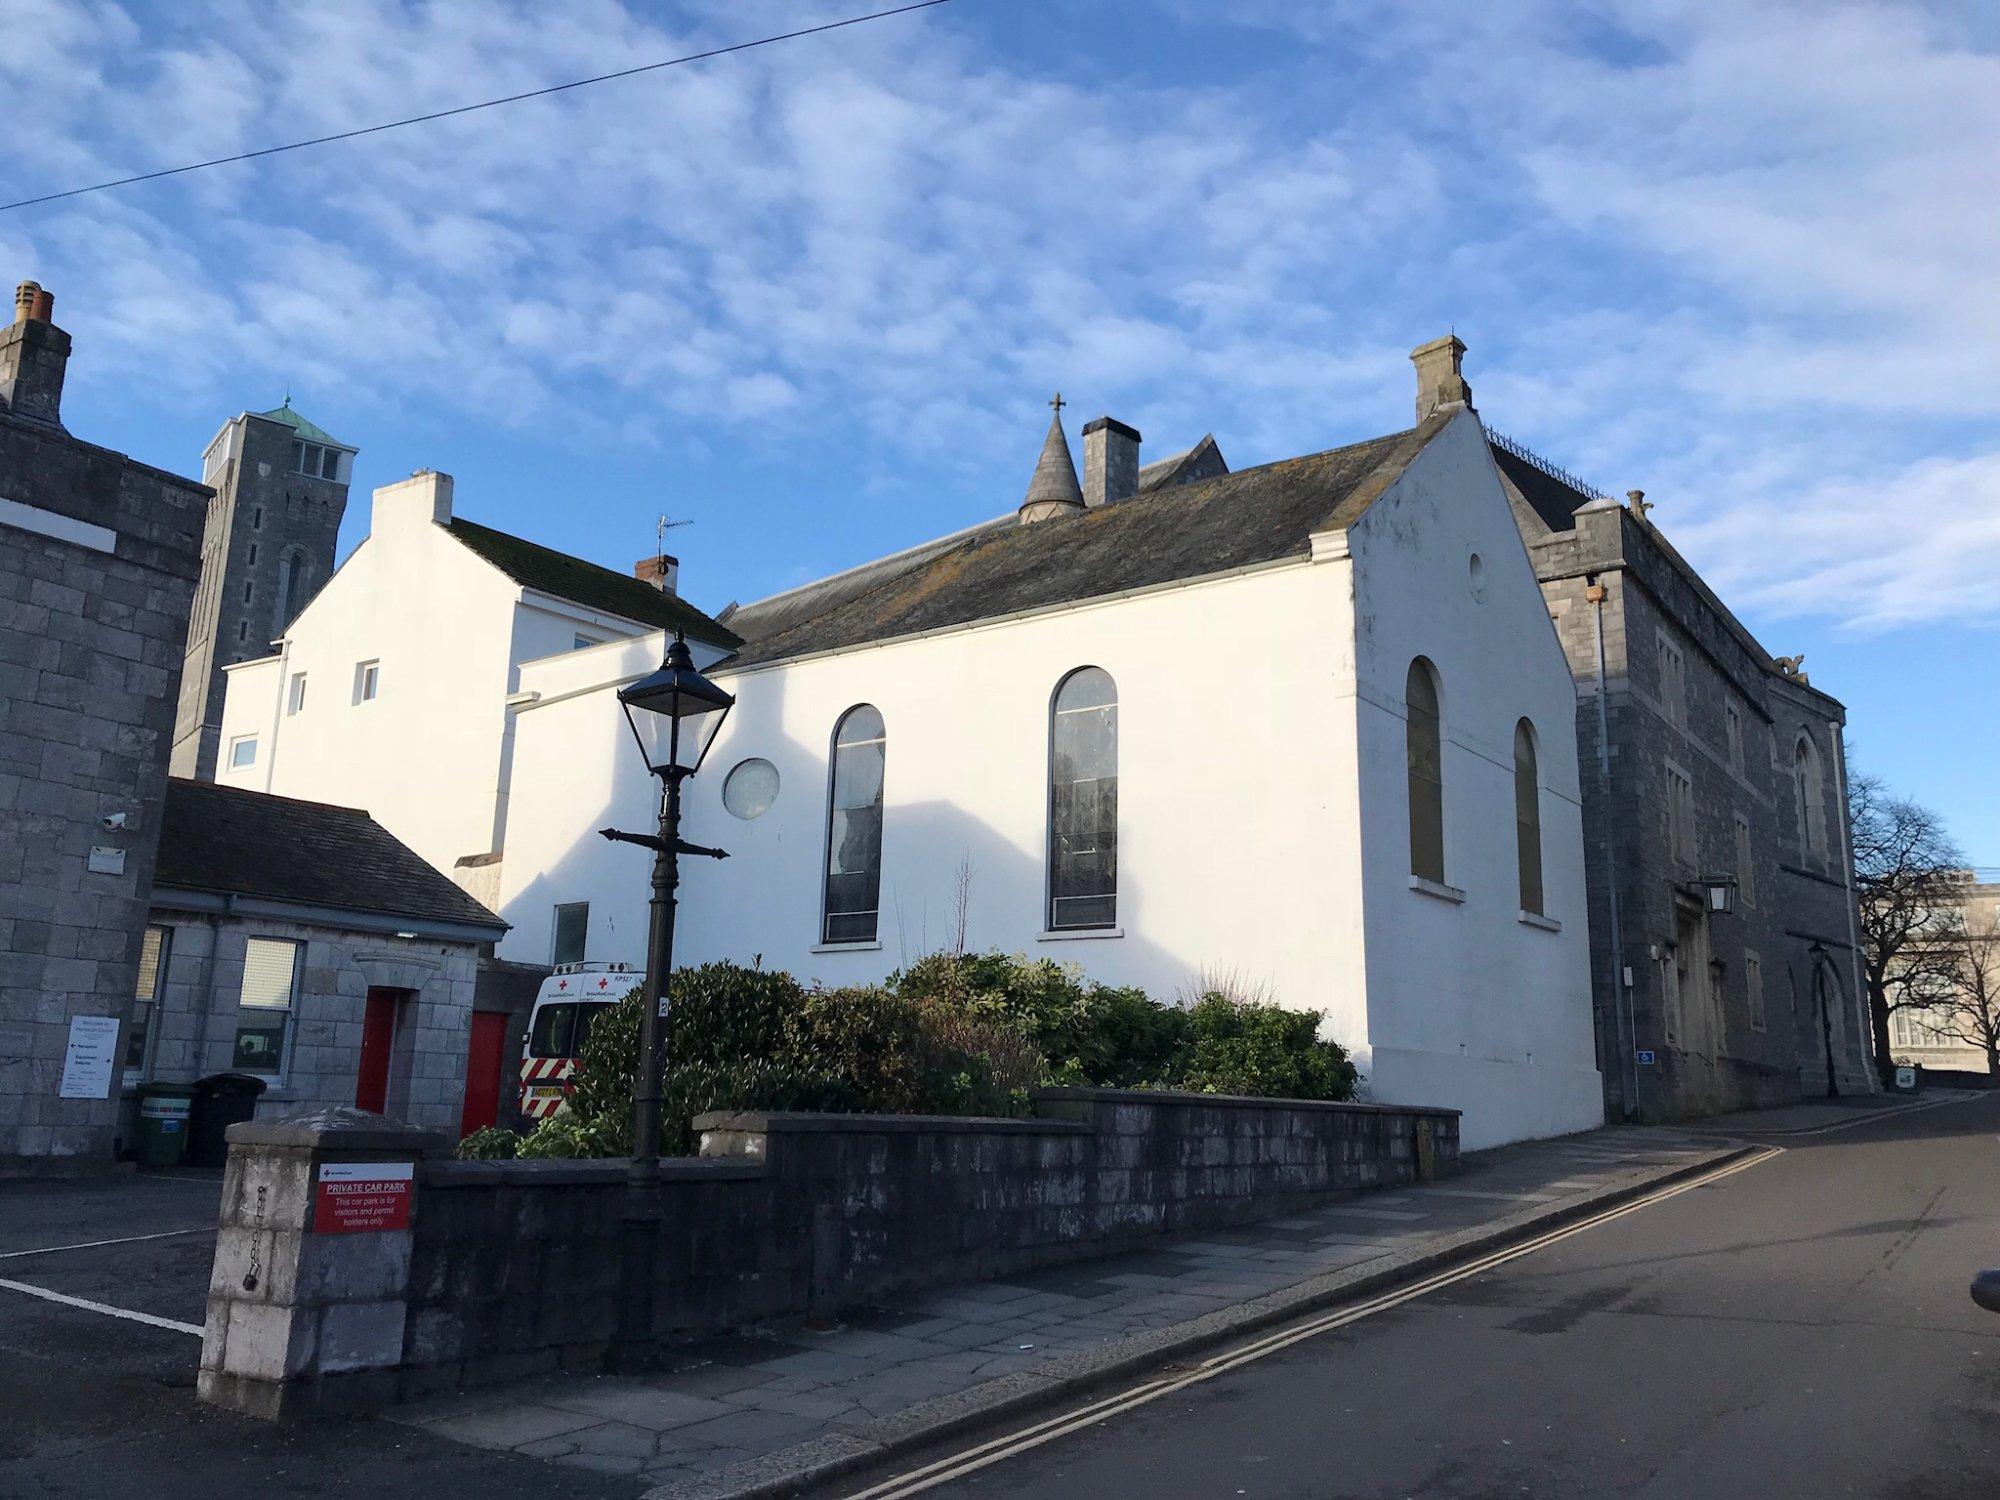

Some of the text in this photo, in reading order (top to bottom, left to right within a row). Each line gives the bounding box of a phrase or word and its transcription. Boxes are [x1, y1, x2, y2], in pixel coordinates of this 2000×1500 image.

[327, 1182, 406, 1193] PRIVATE CAR PARK
[335, 1197, 350, 1206] This
[363, 1197, 379, 1206] park
[380, 1196, 386, 1204] is
[386, 1196, 396, 1204] for
[334, 1207, 394, 1216] visitors and permit
[343, 1218, 384, 1227] holders only
